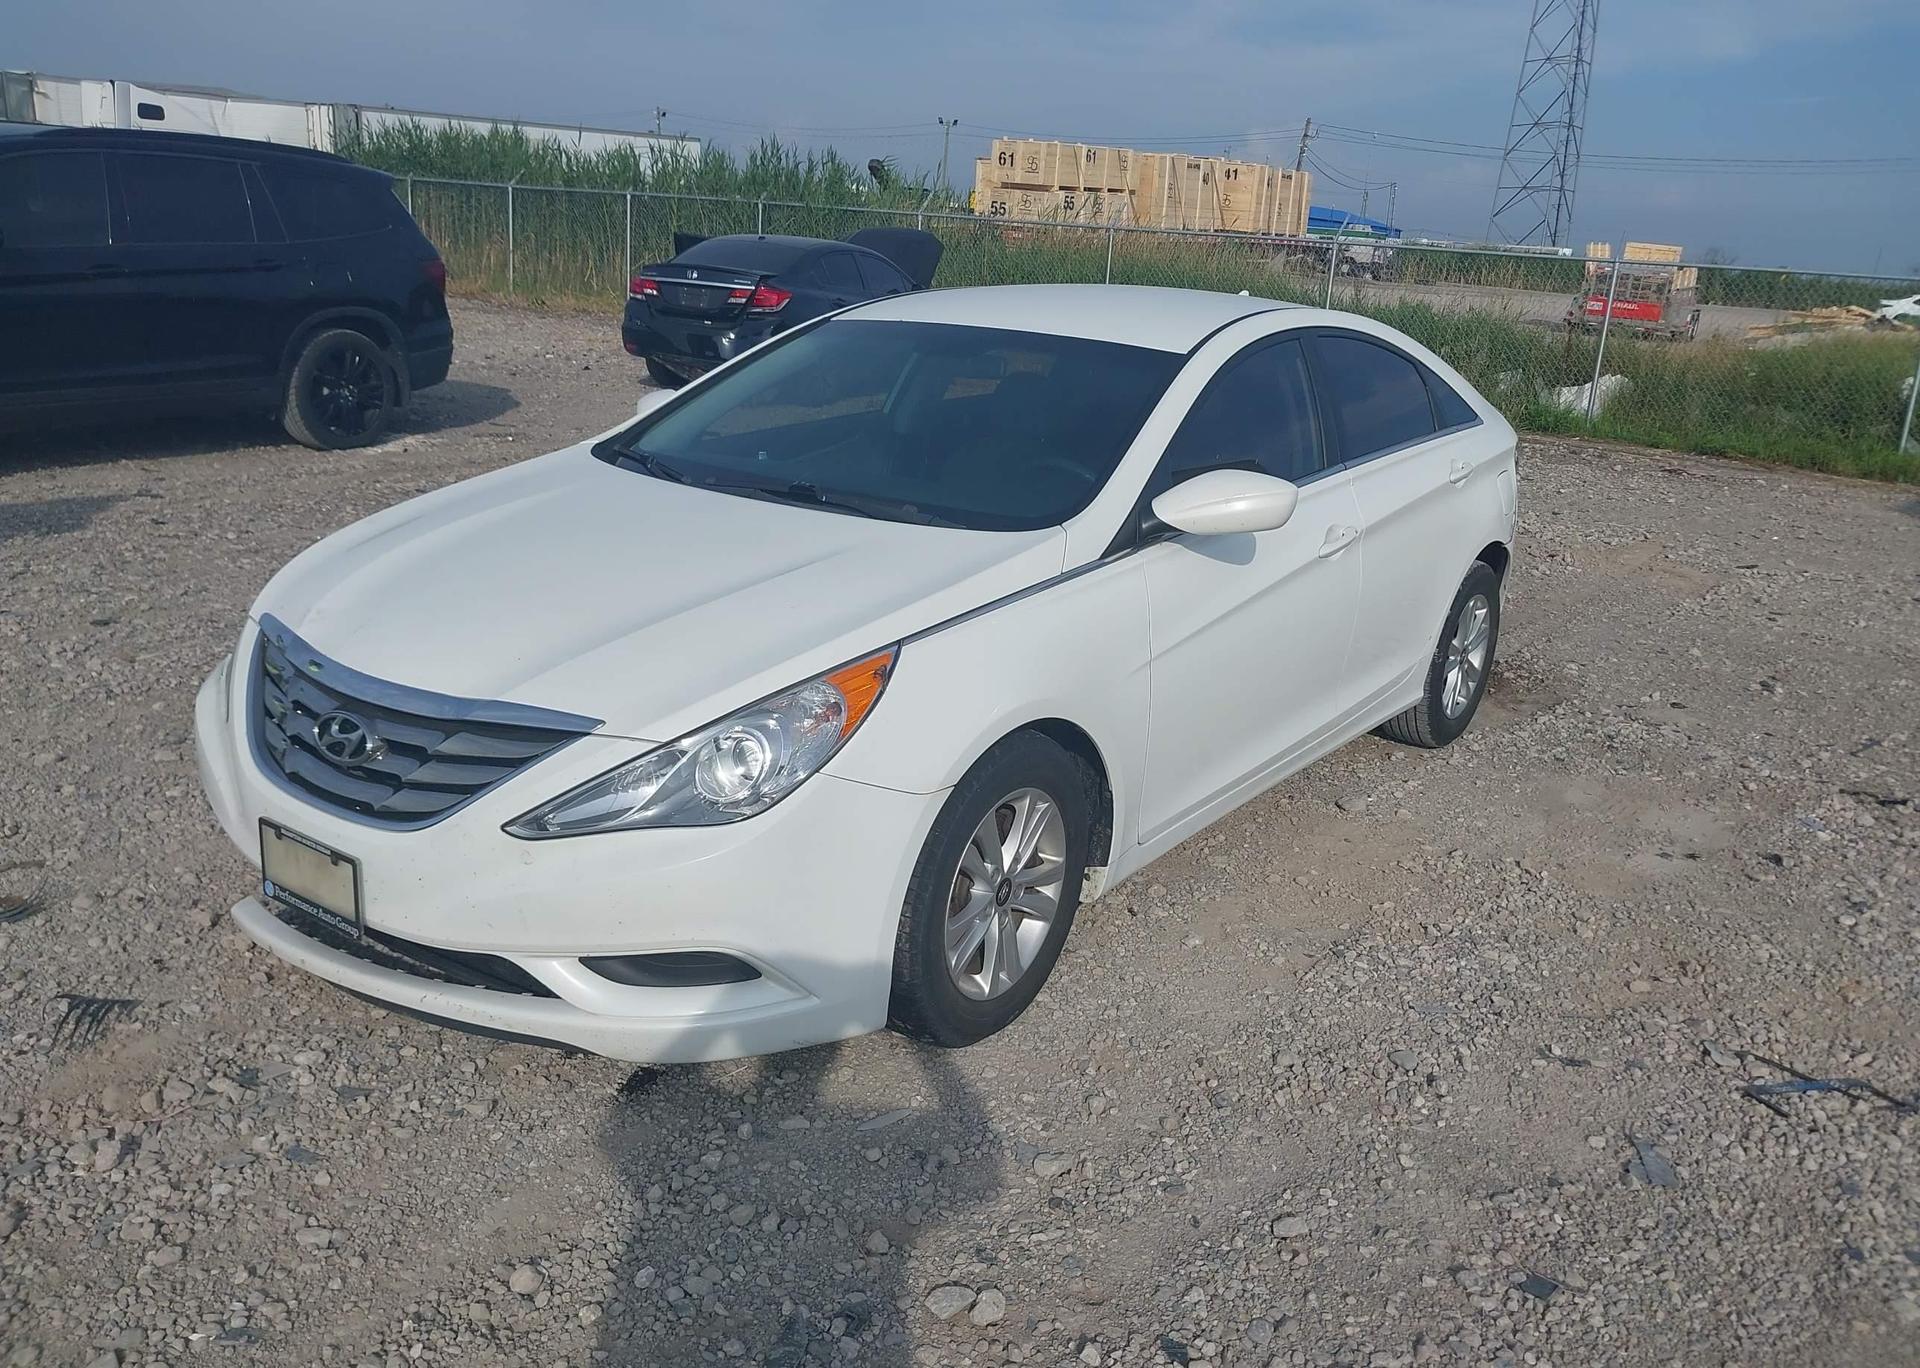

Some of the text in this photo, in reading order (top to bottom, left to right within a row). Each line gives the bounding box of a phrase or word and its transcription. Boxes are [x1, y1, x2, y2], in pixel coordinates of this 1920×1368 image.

[998, 151, 1014, 167] 61
[1086, 149, 1096, 164] 61
[1225, 167, 1238, 180] 41
[990, 201, 1006, 216] 55
[1063, 195, 1075, 210] 55
[274, 885, 359, 940] Performance Auto Group
